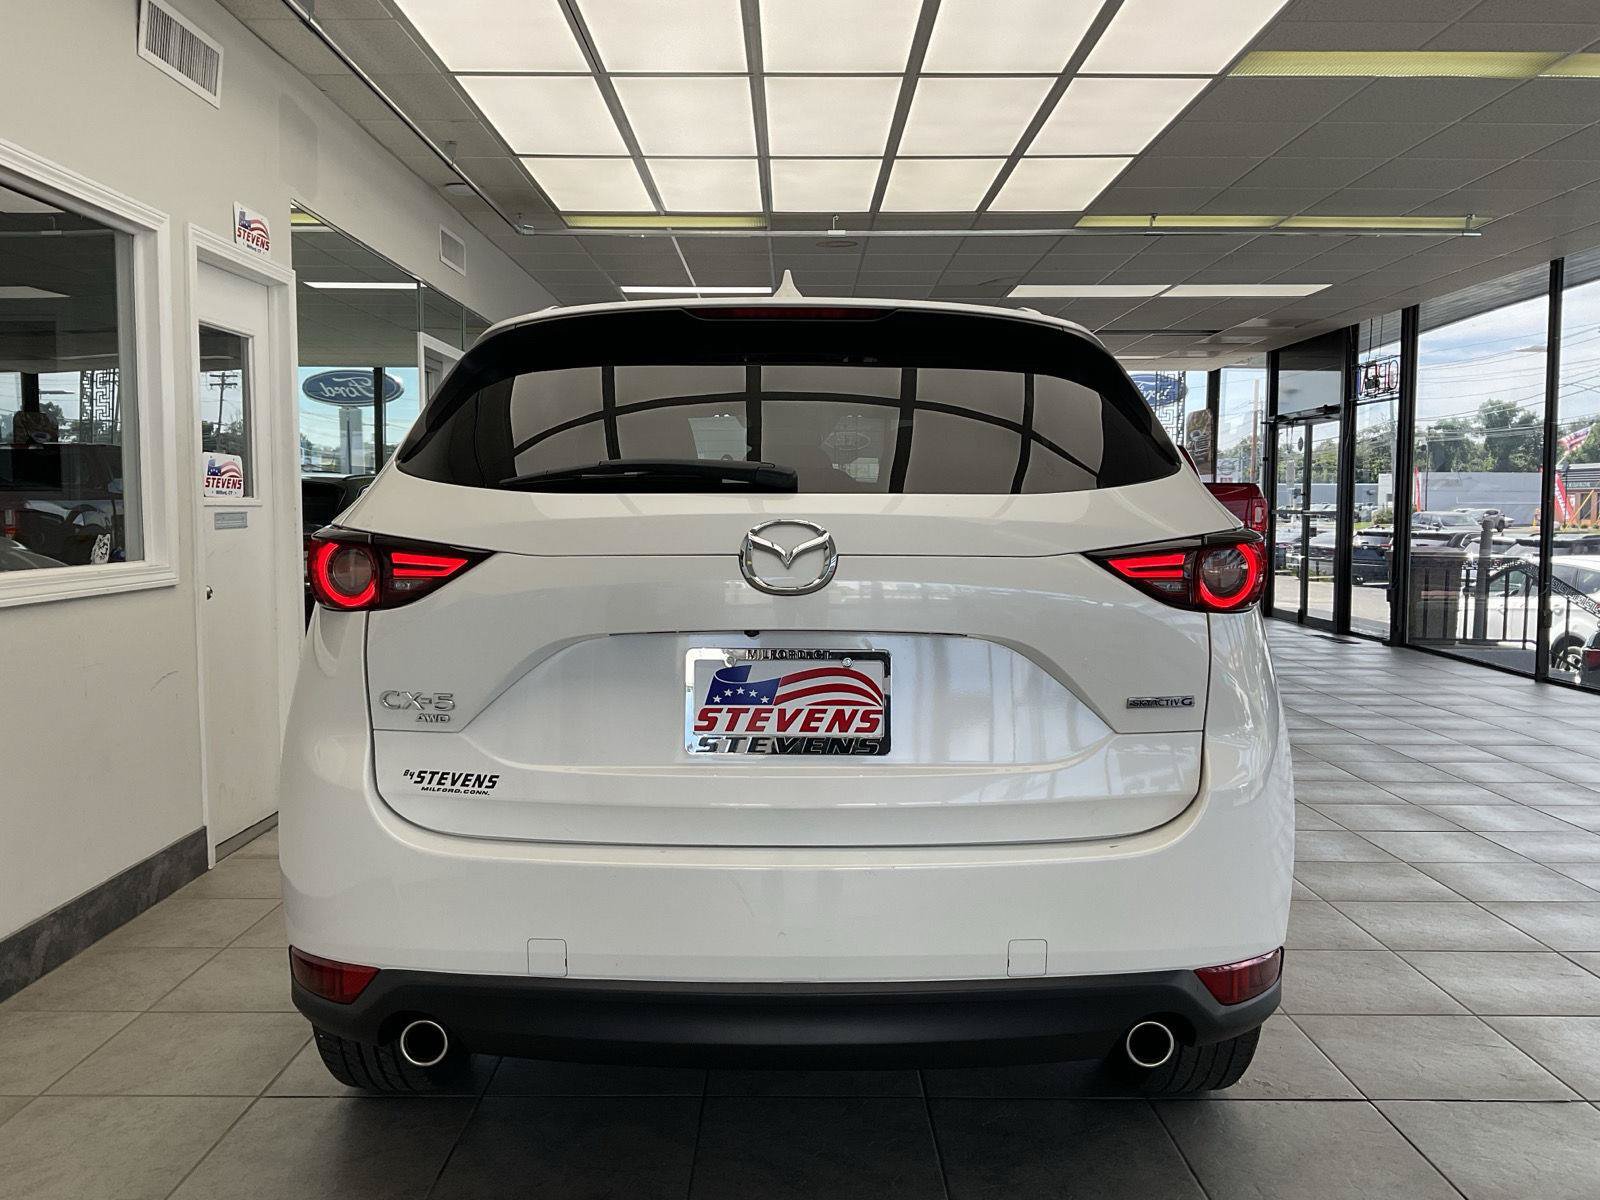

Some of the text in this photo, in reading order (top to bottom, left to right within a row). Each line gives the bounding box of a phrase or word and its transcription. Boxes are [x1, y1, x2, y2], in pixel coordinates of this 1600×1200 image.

[237, 227, 270, 251] STEVENS
[205, 477, 242, 489] STEVENS
[379, 690, 456, 711] CX-5
[416, 713, 451, 723] AWD
[694, 707, 883, 733] STEVENS
[695, 736, 882, 754] STEVENS
[414, 770, 500, 789] STEVENS
